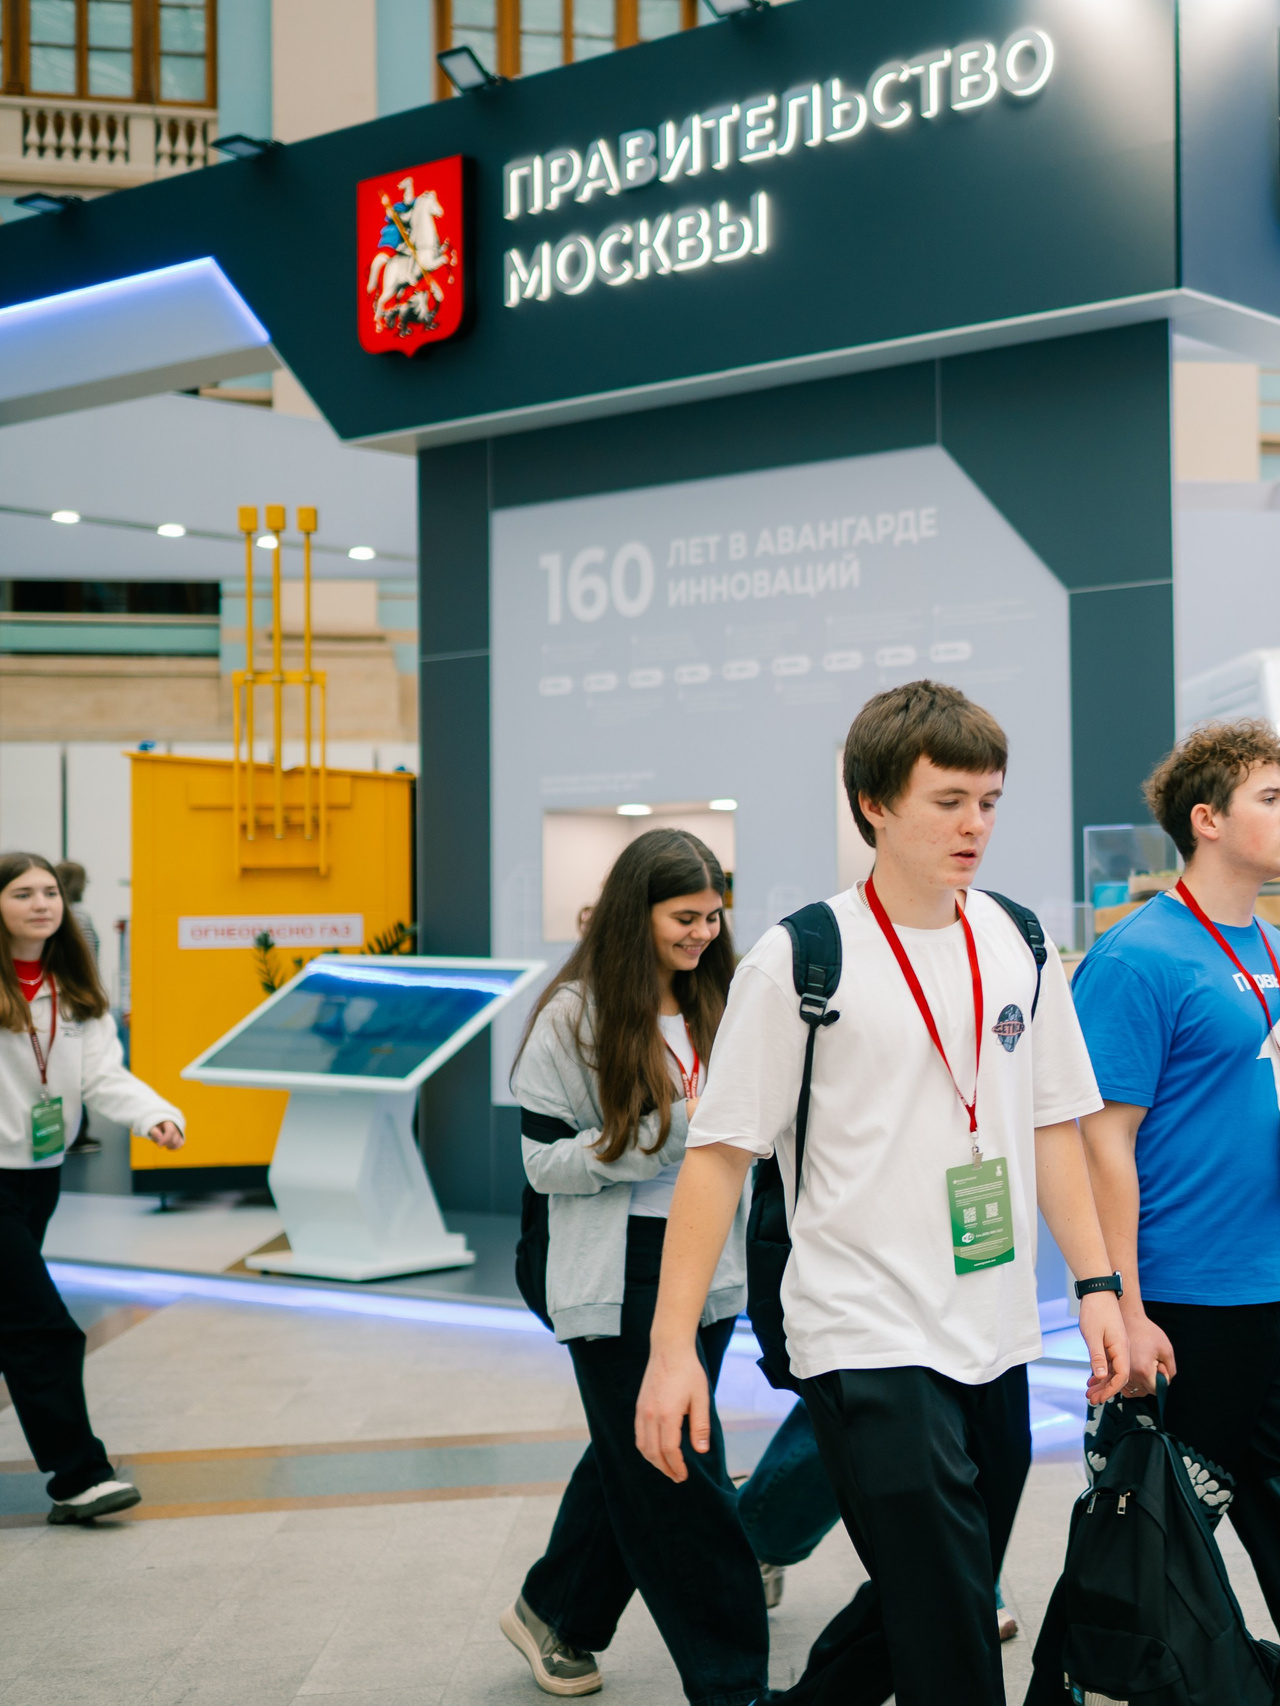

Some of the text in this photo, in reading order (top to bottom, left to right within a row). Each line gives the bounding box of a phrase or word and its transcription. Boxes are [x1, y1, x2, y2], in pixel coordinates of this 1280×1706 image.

[503, 28, 1055, 221] ПРАВИТЕЛЬСТВО
[503, 192, 769, 308] МОСКВЫ
[667, 507, 938, 569] ЛЕТ В АВАНГАРДЕ
[538, 540, 655, 626] 160
[667, 554, 862, 608] ИННОВАЦИЙ
[319, 922, 352, 939] ГАЗ
